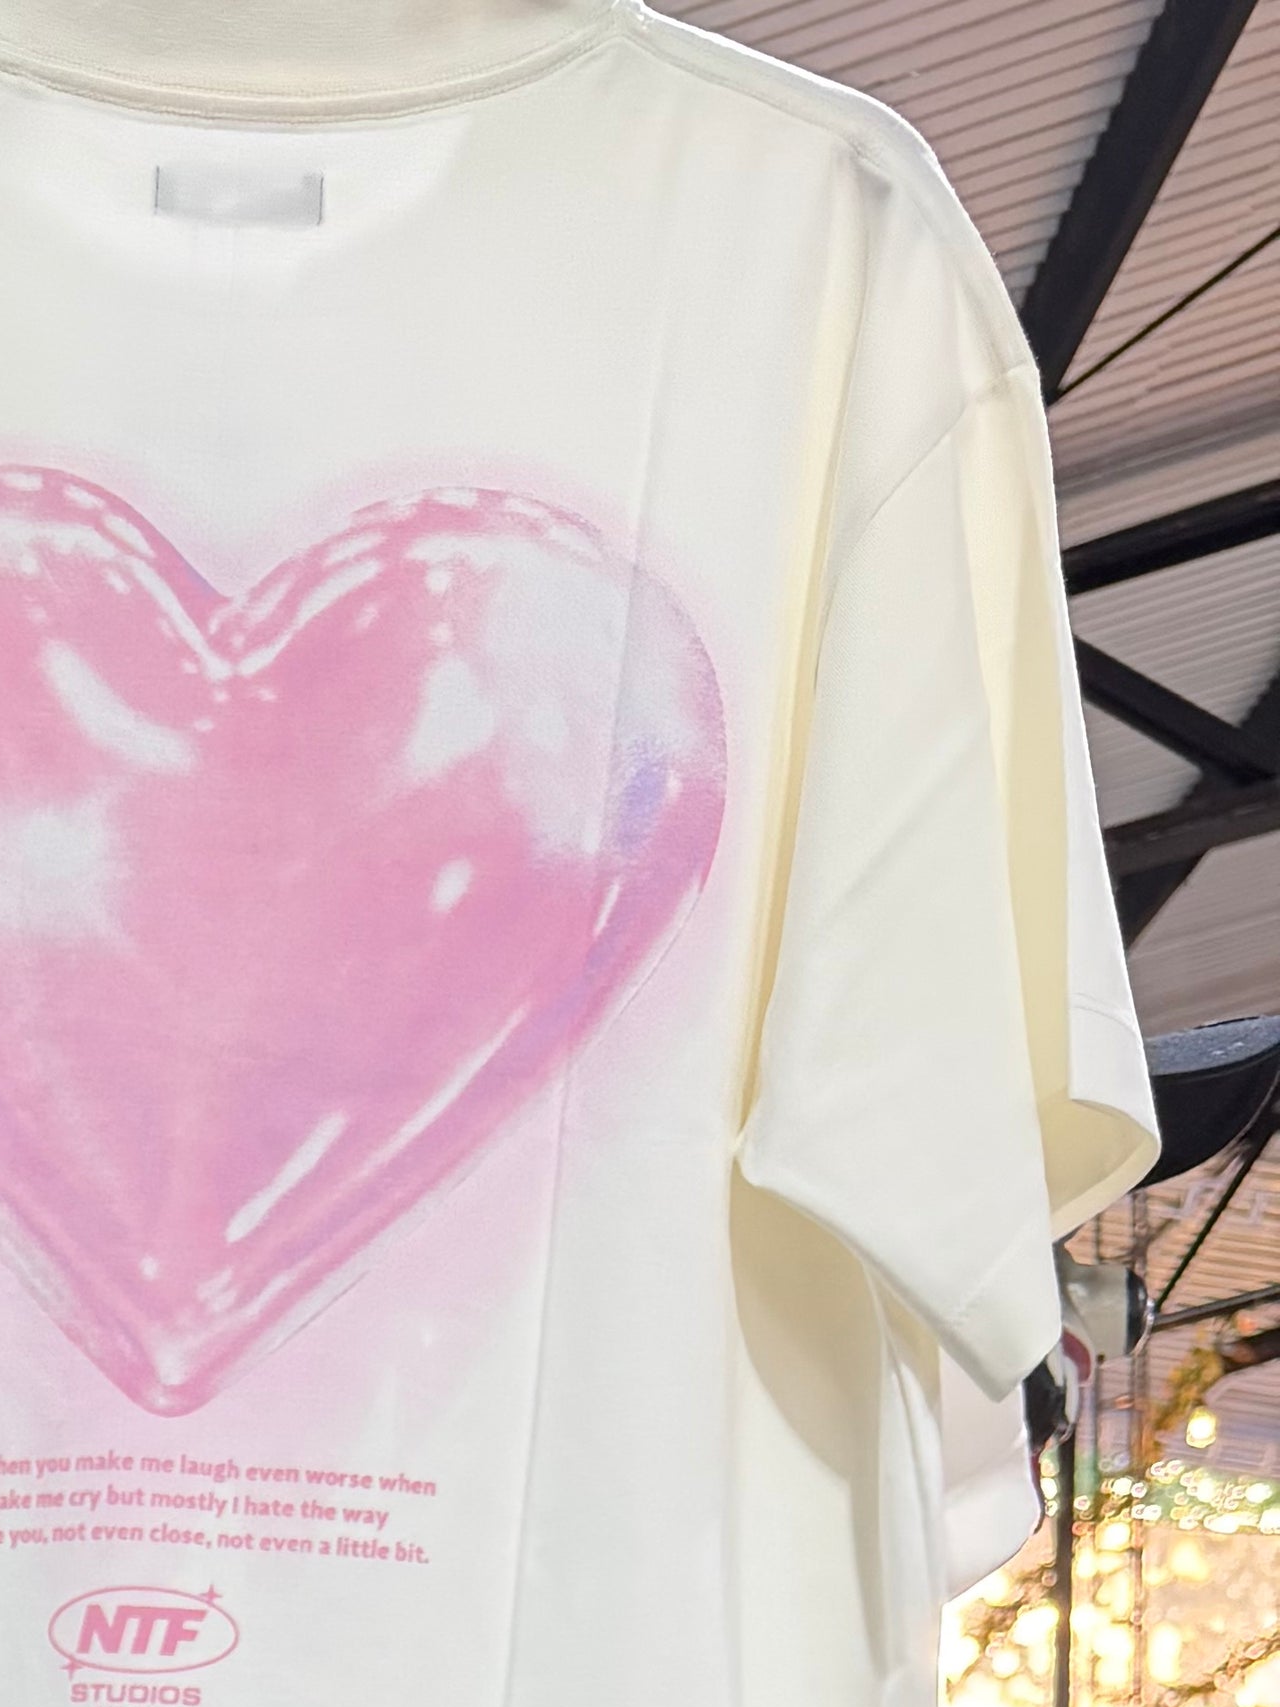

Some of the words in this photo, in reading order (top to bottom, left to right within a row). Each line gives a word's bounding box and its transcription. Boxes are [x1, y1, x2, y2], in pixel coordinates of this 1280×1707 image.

[36, 1457, 71, 1479] you
[75, 1450, 134, 1471] make
[140, 1457, 174, 1473] me
[180, 1454, 240, 1483] laugh
[245, 1466, 300, 1483] even
[305, 1468, 373, 1490] worse
[378, 1473, 437, 1497] when
[35, 1493, 65, 1509] me
[68, 1489, 101, 1511] cry
[106, 1484, 145, 1507] but
[150, 1491, 227, 1518] mostly
[231, 1496, 239, 1515] I
[243, 1496, 294, 1518] hate
[300, 1500, 337, 1521] the
[342, 1506, 390, 1531] way
[9, 1528, 48, 1549] you,
[52, 1523, 86, 1542] not
[91, 1525, 143, 1542] even
[149, 1523, 212, 1549] close,
[217, 1532, 254, 1551] not
[259, 1536, 313, 1553] even
[318, 1539, 331, 1556] a
[336, 1537, 390, 1560] little
[395, 1541, 430, 1564] bit.
[76, 1604, 209, 1656] NTF
[70, 1683, 202, 1706] STUDIOS
